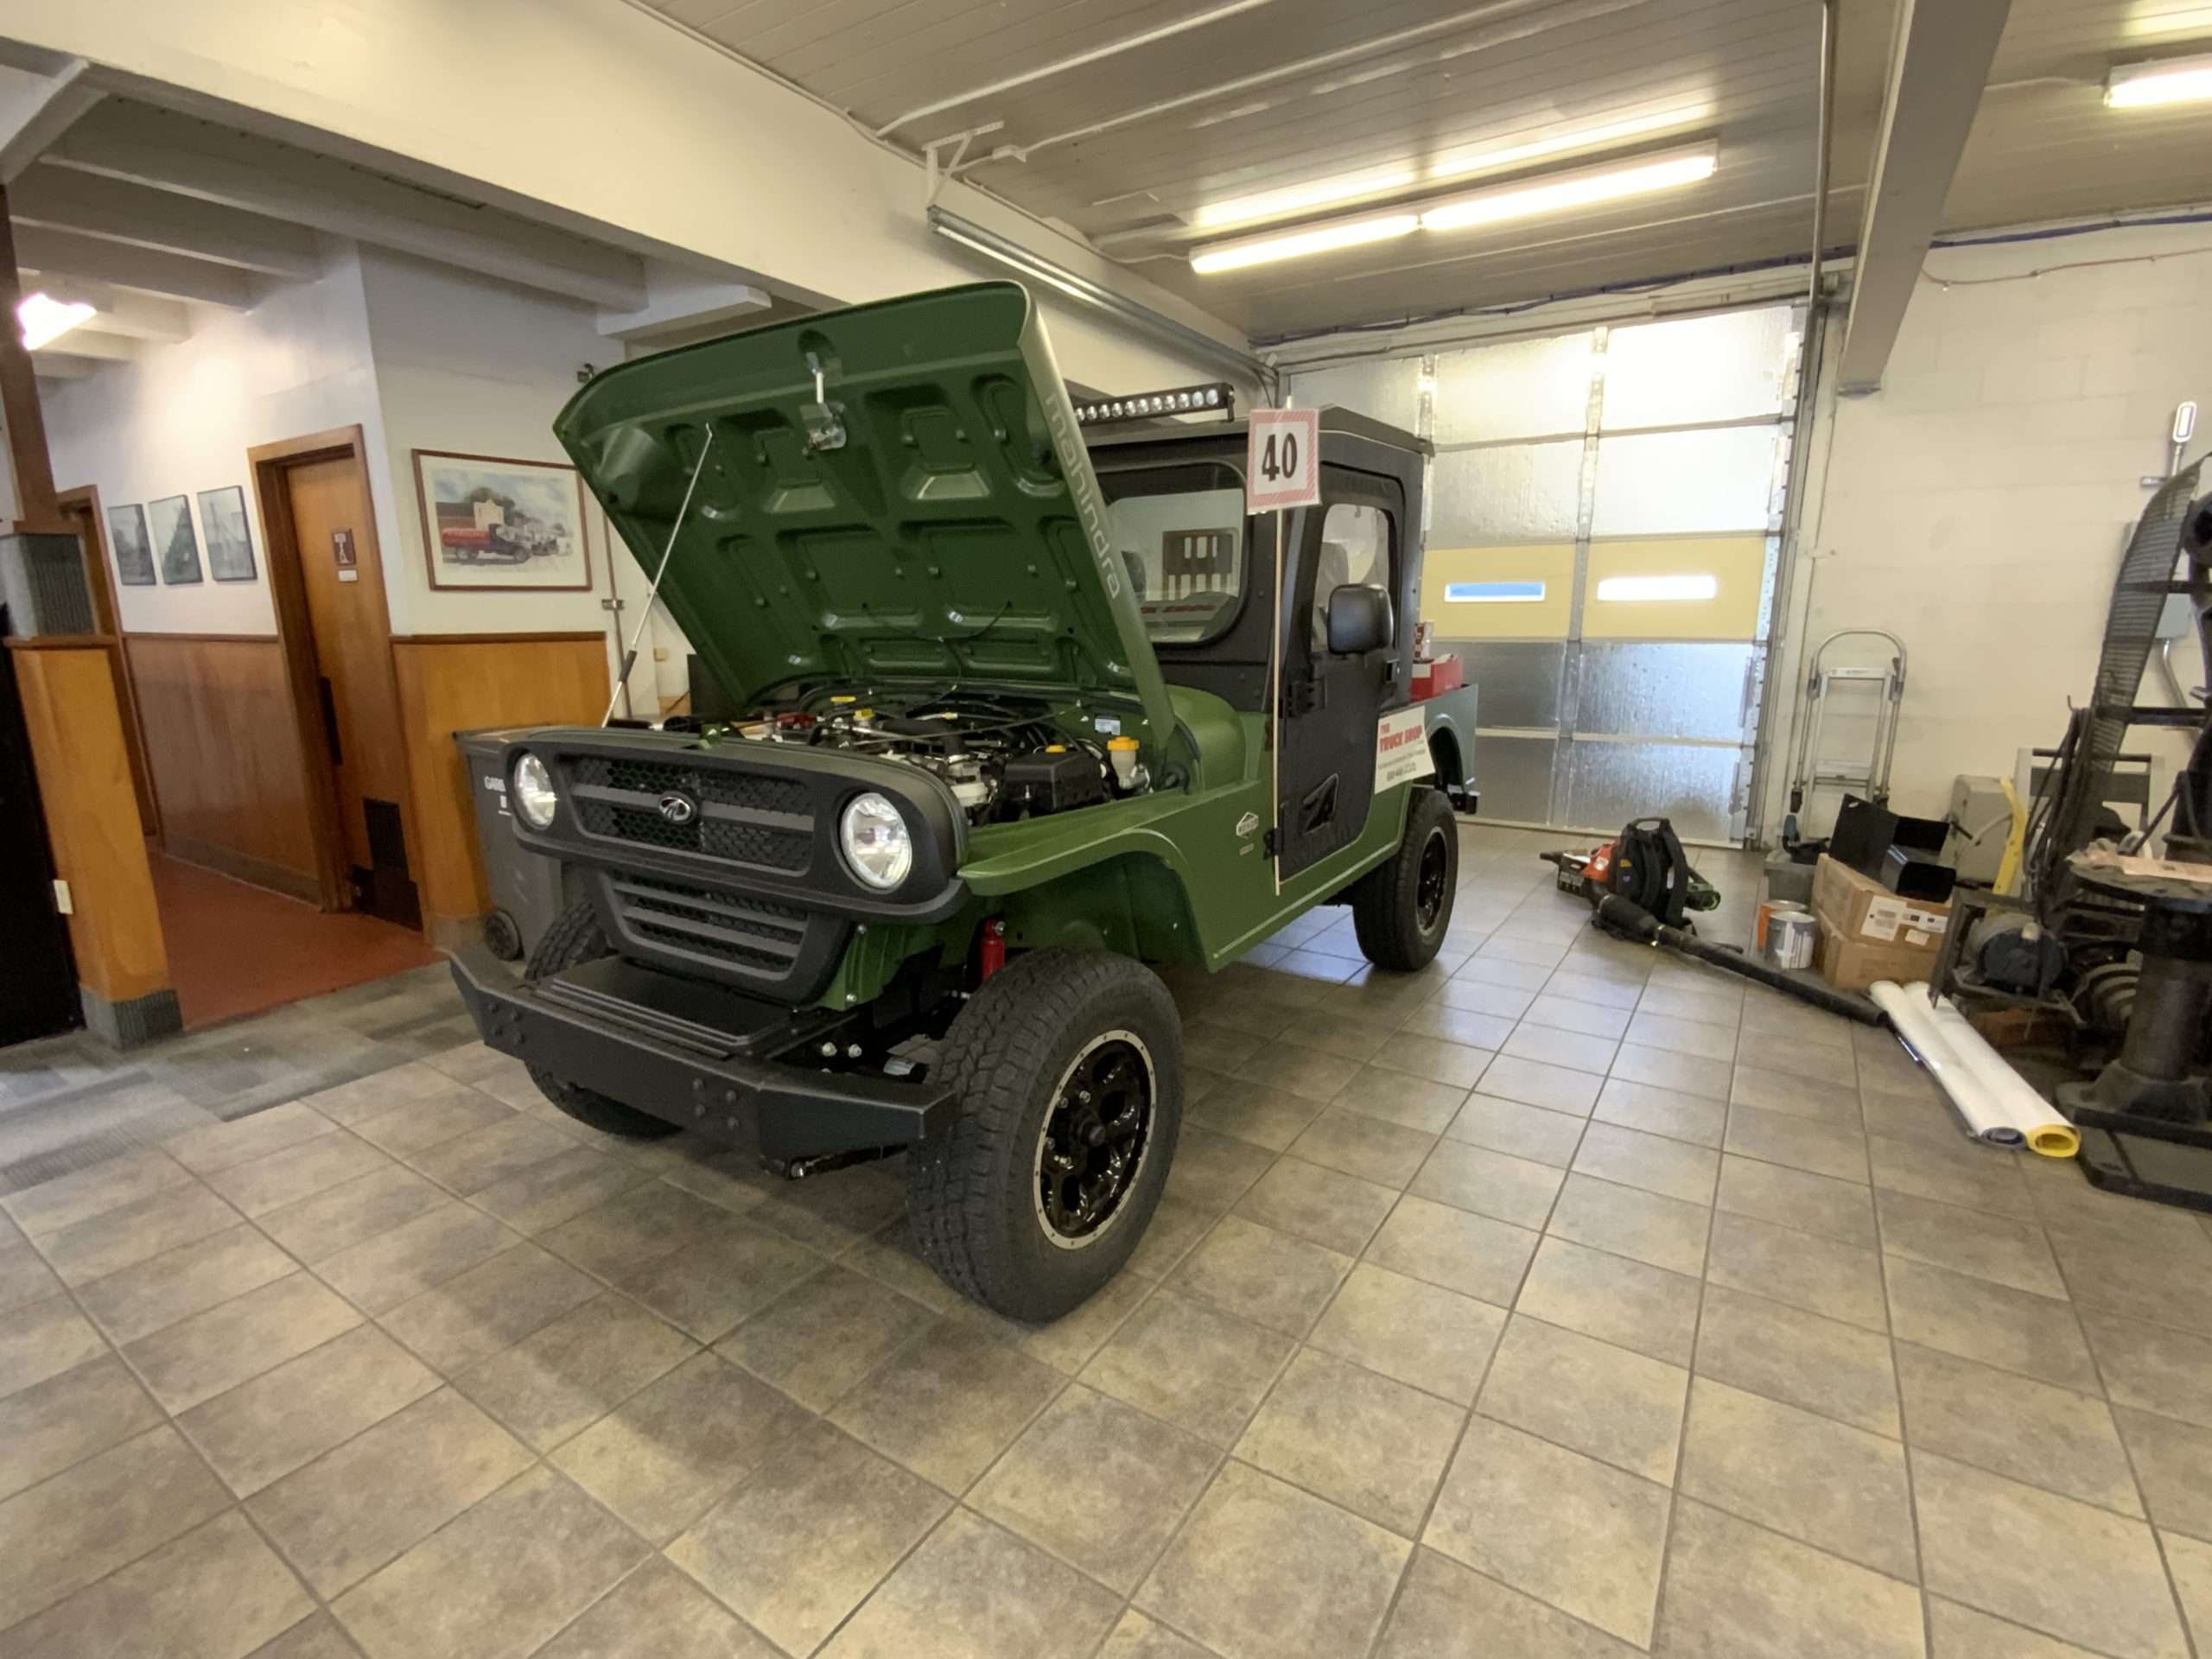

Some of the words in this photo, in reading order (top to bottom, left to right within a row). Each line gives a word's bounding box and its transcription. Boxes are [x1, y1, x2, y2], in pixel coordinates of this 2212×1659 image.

[1261, 432, 1298, 482] 40
[1046, 393, 1121, 600] mahindra
[1380, 732, 1403, 753] TRUCK
[1404, 725, 1422, 744] SHOP
